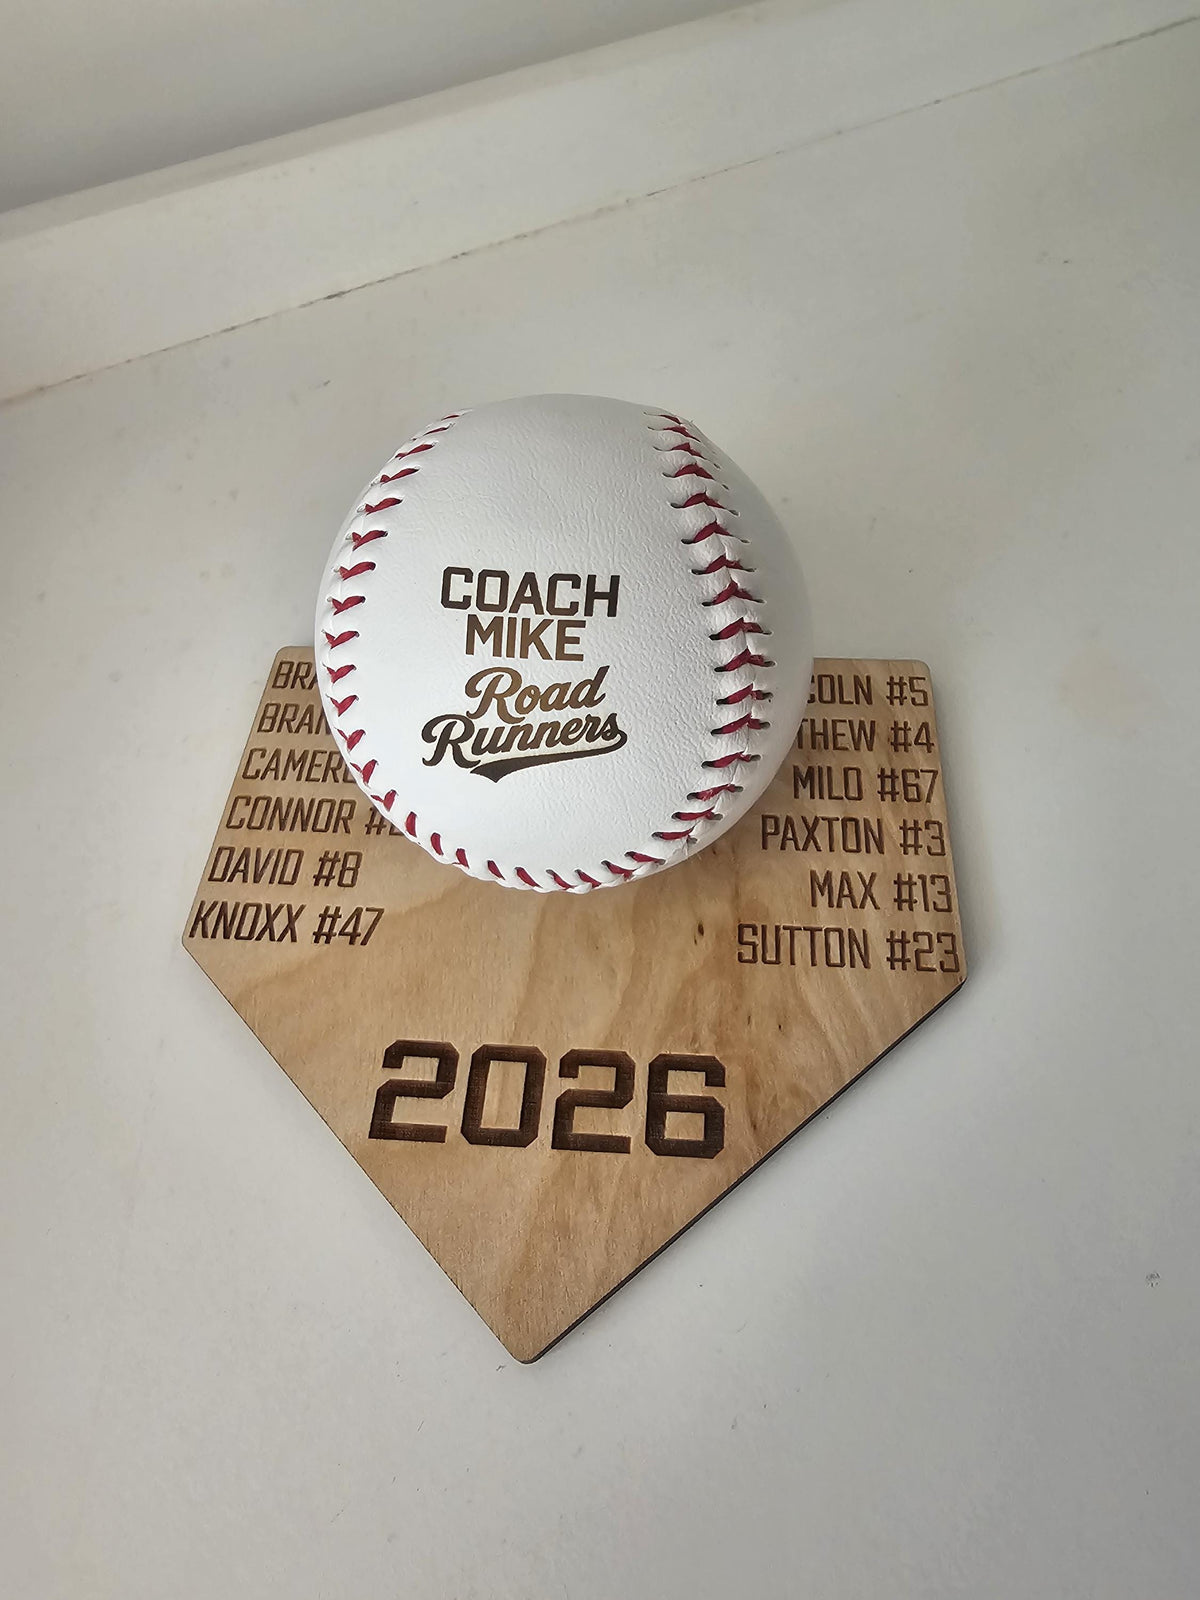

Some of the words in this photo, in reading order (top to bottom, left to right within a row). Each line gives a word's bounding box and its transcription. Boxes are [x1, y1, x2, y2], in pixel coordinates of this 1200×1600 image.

[441, 566, 620, 617] COACH
[465, 614, 586, 661] MIKE
[465, 665, 610, 724] Road
[886, 676, 928, 706] #5
[421, 712, 624, 769] Runners
[890, 721, 934, 753] #4
[793, 765, 863, 801] MILO
[877, 767, 938, 803] #67
[226, 796, 357, 833] CONNOR
[761, 814, 885, 855] PAXTON
[900, 819, 946, 856] #3
[208, 847, 304, 885] DAVID
[313, 851, 363, 887] #8
[810, 870, 880, 910] MAX
[893, 872, 953, 912] #13
[189, 900, 306, 942] KNOXX
[313, 905, 384, 946] #47
[737, 923, 871, 969] SUTTON
[886, 930, 960, 973] #23
[368, 1039, 726, 1159] 2026
